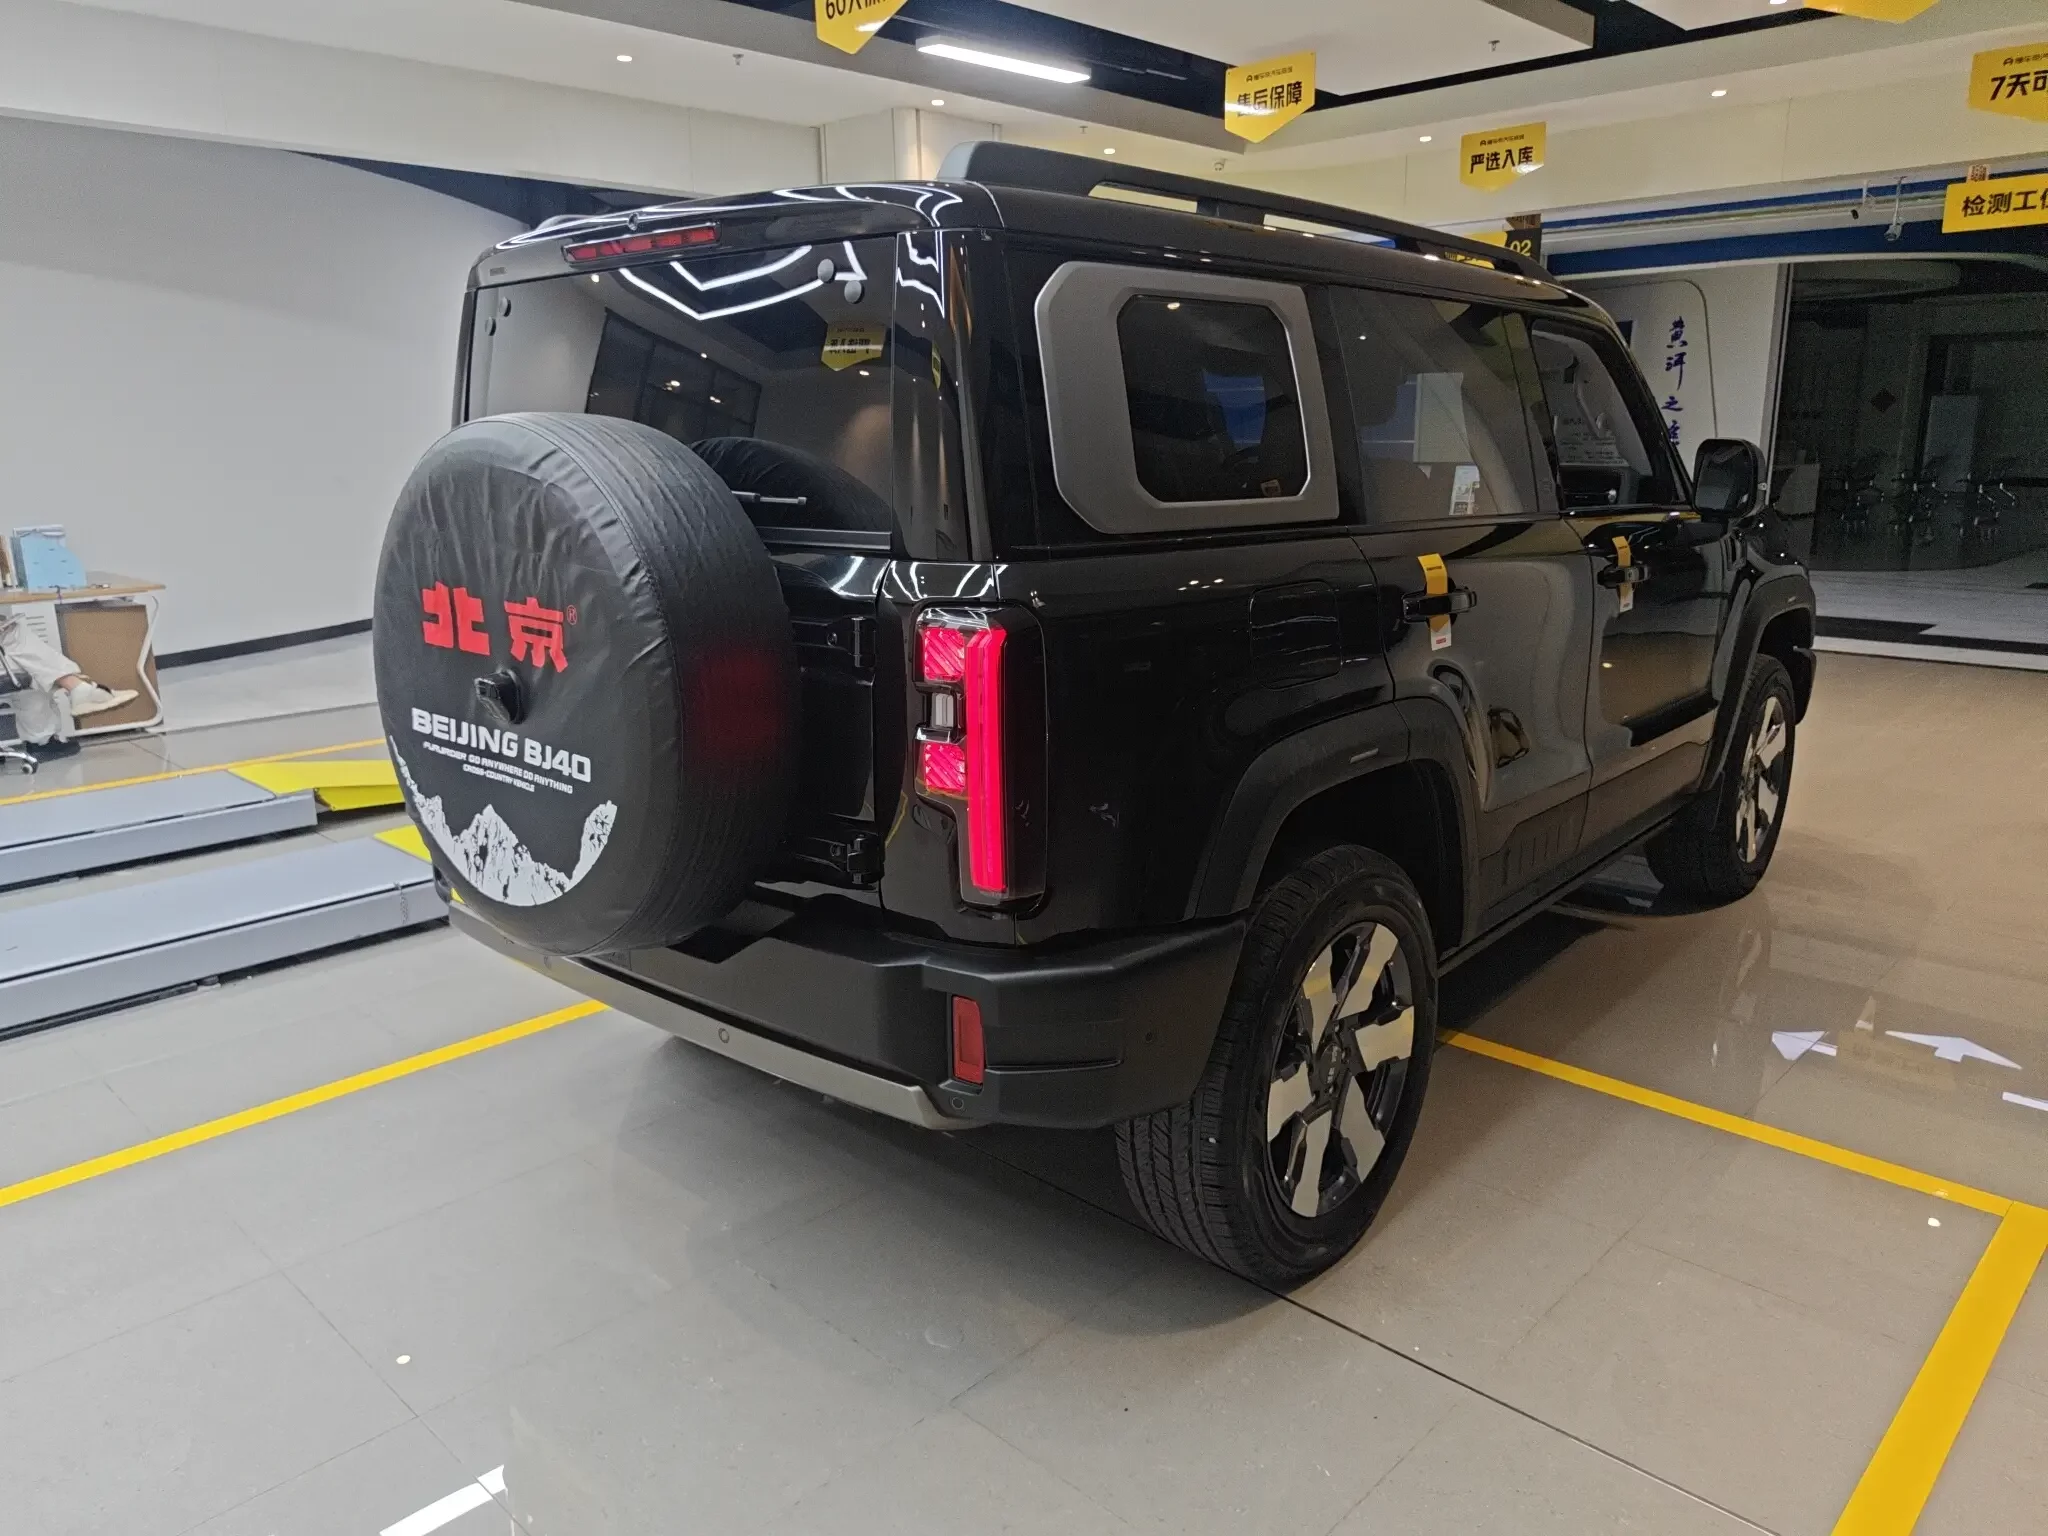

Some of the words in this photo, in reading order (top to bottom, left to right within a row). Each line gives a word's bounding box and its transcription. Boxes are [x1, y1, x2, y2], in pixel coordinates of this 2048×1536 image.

[1237, 81, 1303, 116] 售后保障
[1469, 146, 1534, 174] 严选入库
[421, 581, 568, 673] 北京
[411, 707, 519, 757] BEIJING
[523, 737, 592, 783] BJ40
[462, 763, 514, 785] CROSS-COUNTRY
[468, 754, 481, 765] GO
[481, 757, 523, 777] ANYWHERE
[523, 770, 534, 781] DO
[533, 773, 573, 794] ANYTHING
